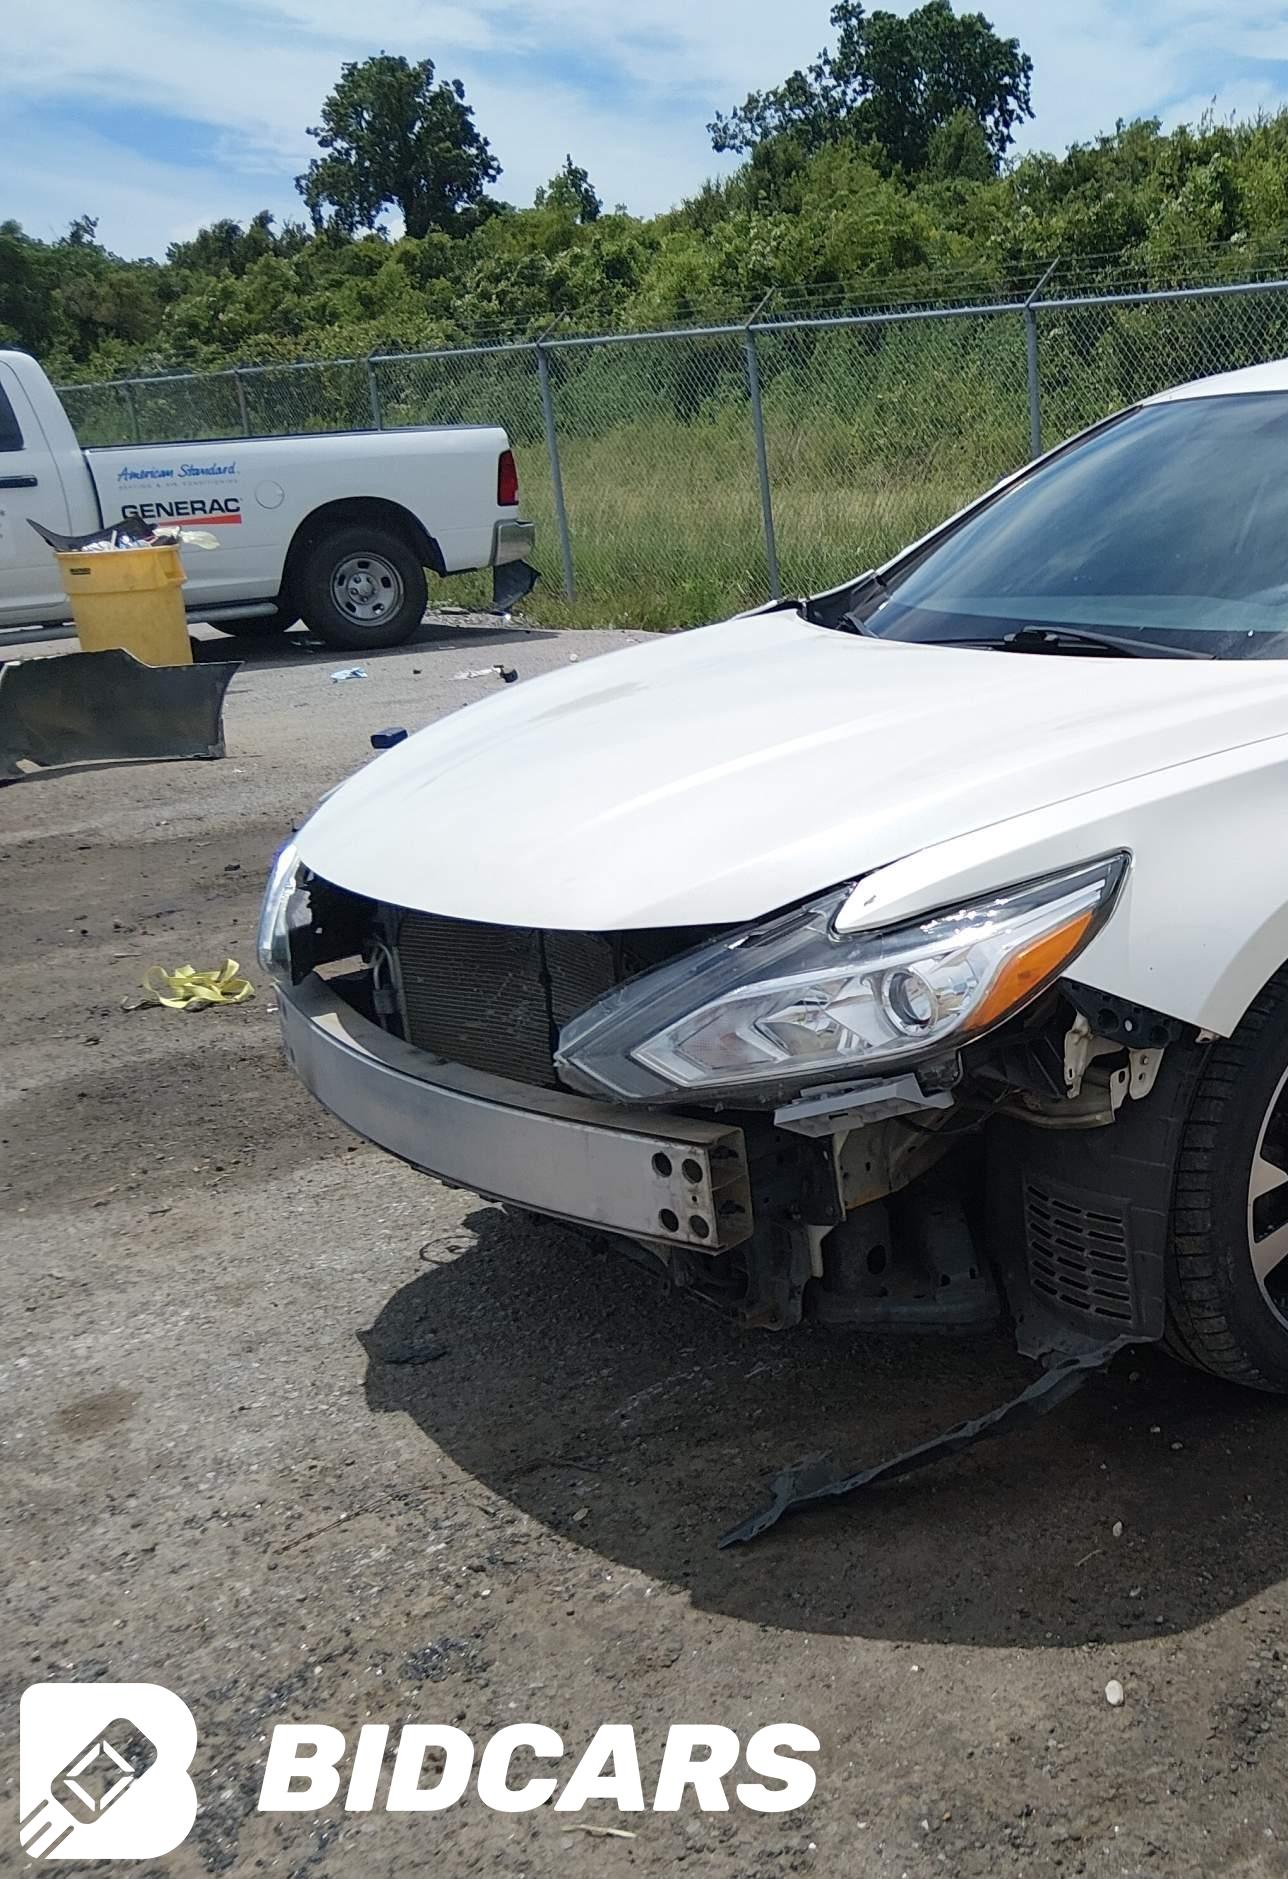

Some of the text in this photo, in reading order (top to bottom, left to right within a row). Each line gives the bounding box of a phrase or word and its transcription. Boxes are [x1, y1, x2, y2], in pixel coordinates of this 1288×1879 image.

[117, 461, 237, 481] American Standard
[121, 498, 241, 519] GENERAC
